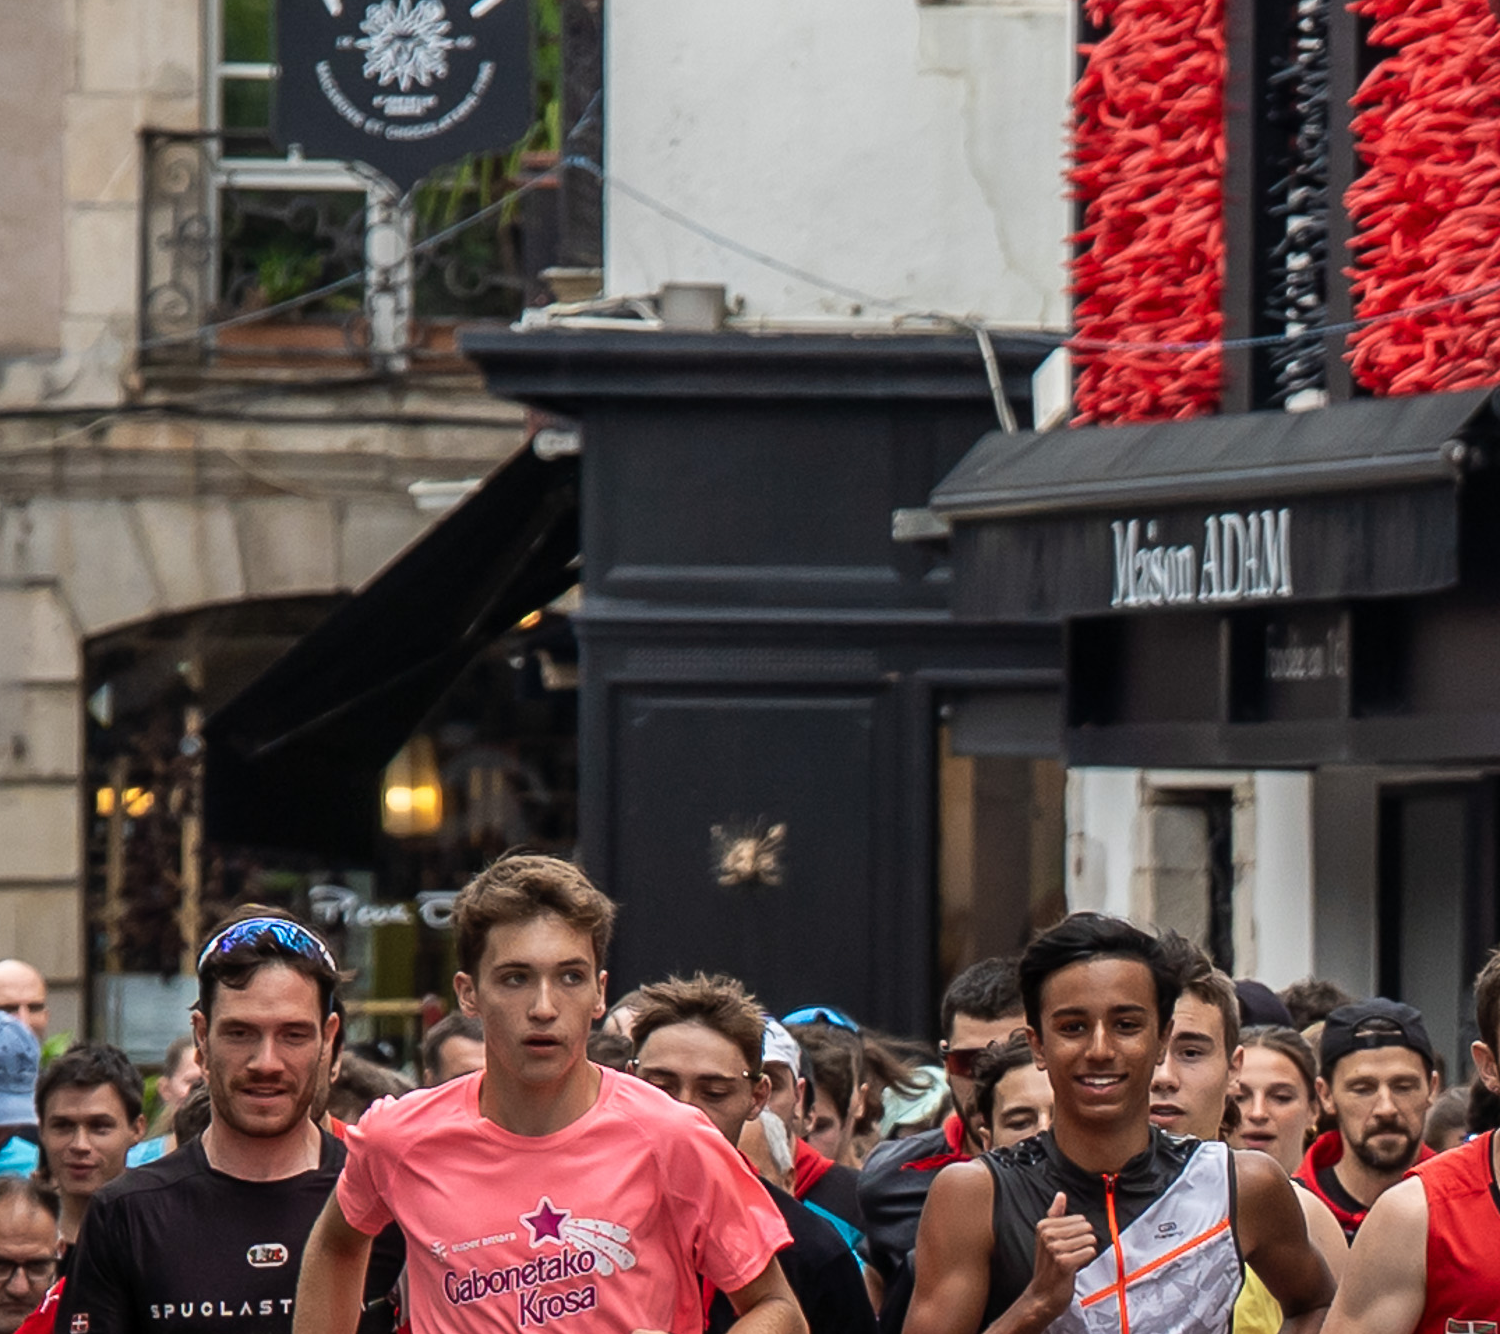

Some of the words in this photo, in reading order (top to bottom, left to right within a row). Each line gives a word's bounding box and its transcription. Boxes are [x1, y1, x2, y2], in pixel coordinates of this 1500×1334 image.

[1111, 519, 1197, 608] Maison
[1198, 508, 1293, 603] ADAM
[445, 1247, 596, 1305] Gabonetako
[518, 1285, 596, 1327] Krosa
